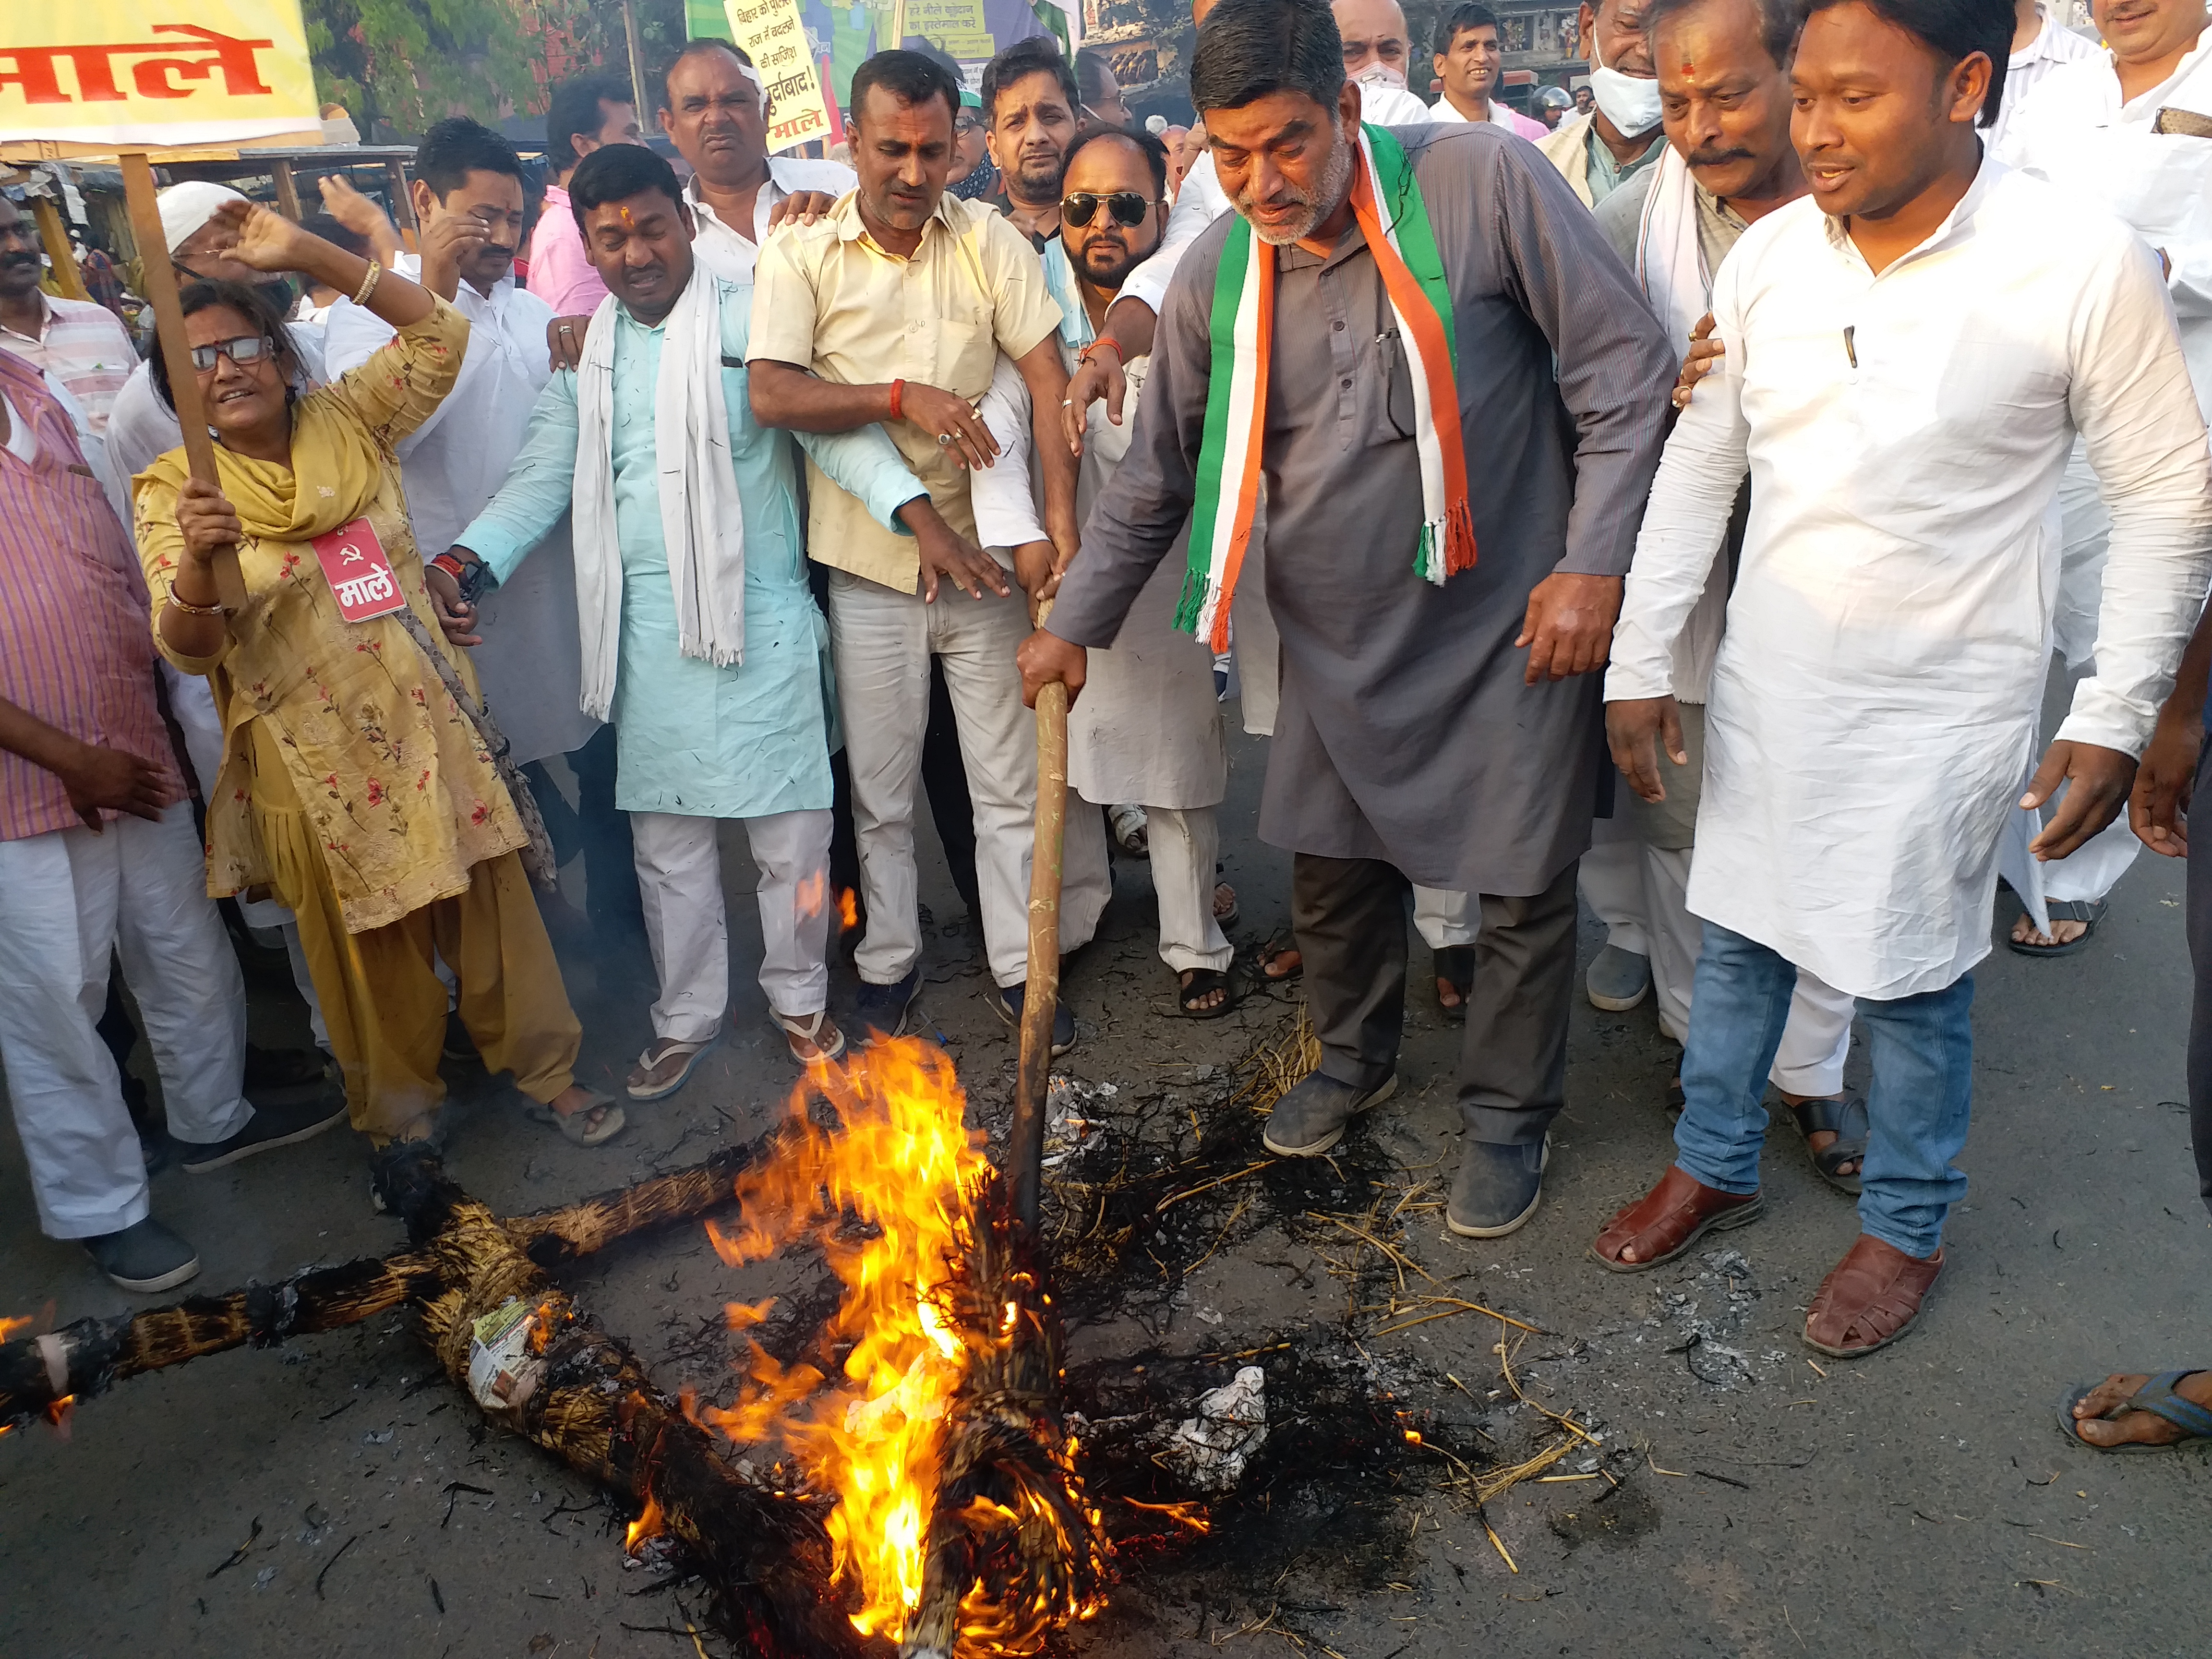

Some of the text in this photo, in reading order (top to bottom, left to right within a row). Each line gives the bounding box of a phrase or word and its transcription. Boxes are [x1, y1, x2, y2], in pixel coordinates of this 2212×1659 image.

[737, 9, 758, 24] बिहार
[748, 33, 763, 48] राज
[770, 15, 795, 37] बदलने
[759, 53, 770, 69] की
[770, 46, 797, 65] साजिश
[769, 108, 823, 138] माले
[334, 562, 393, 607] माले
